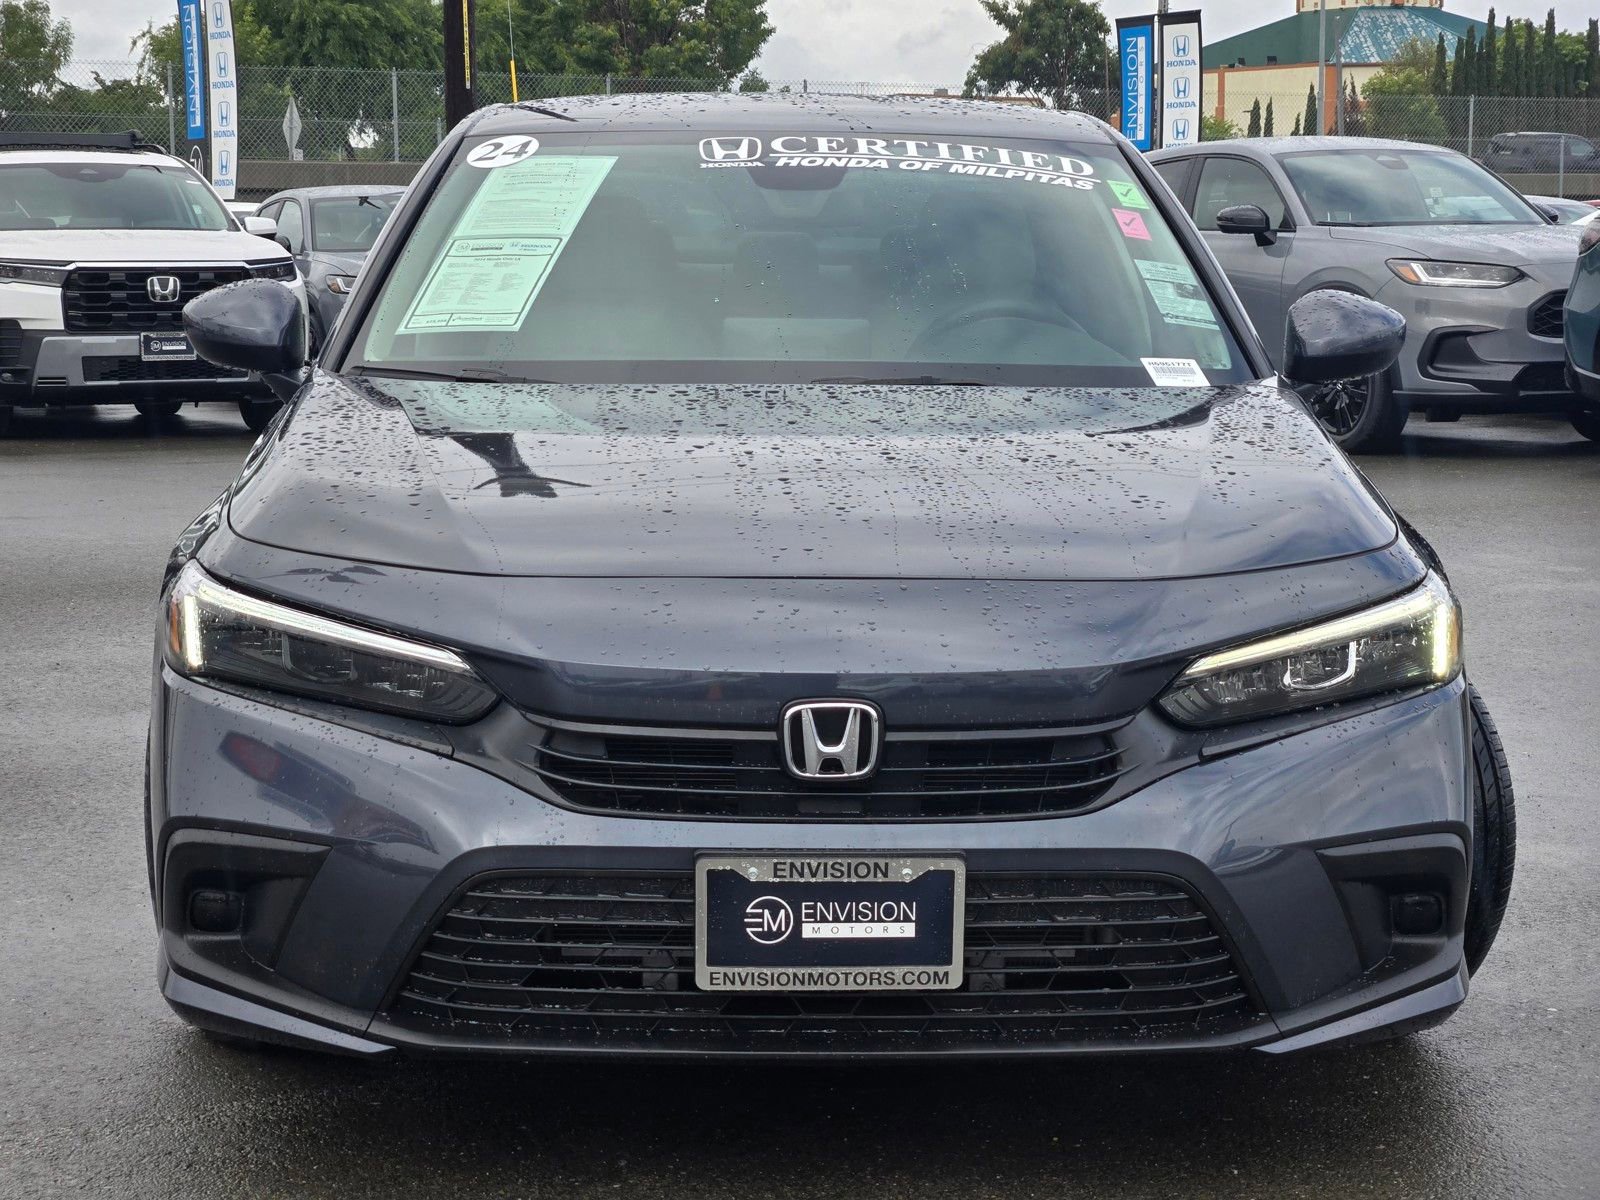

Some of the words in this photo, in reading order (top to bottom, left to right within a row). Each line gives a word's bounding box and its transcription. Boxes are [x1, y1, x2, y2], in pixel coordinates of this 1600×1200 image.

[209, 30, 231, 40] HONDA
[183, 5, 197, 127] ENVISION
[1166, 59, 1197, 68] HONDA
[211, 80, 235, 89] HONDA
[1126, 37, 1138, 141] ENVISION
[1166, 101, 1197, 109] HONDA
[213, 130, 236, 138] HONDA
[471, 140, 533, 162] 24
[770, 136, 1095, 176] CERTIFIED
[774, 157, 889, 168] HONDA
[898, 160, 943, 171] OF
[948, 163, 1095, 190] MILPITAS
[213, 178, 234, 187] HONDA
[773, 862, 889, 879] ENVISION
[801, 901, 916, 921] ENVISION
[811, 925, 905, 934] MOTORS
[709, 970, 950, 987] ENVISIONMOTORS.COM
